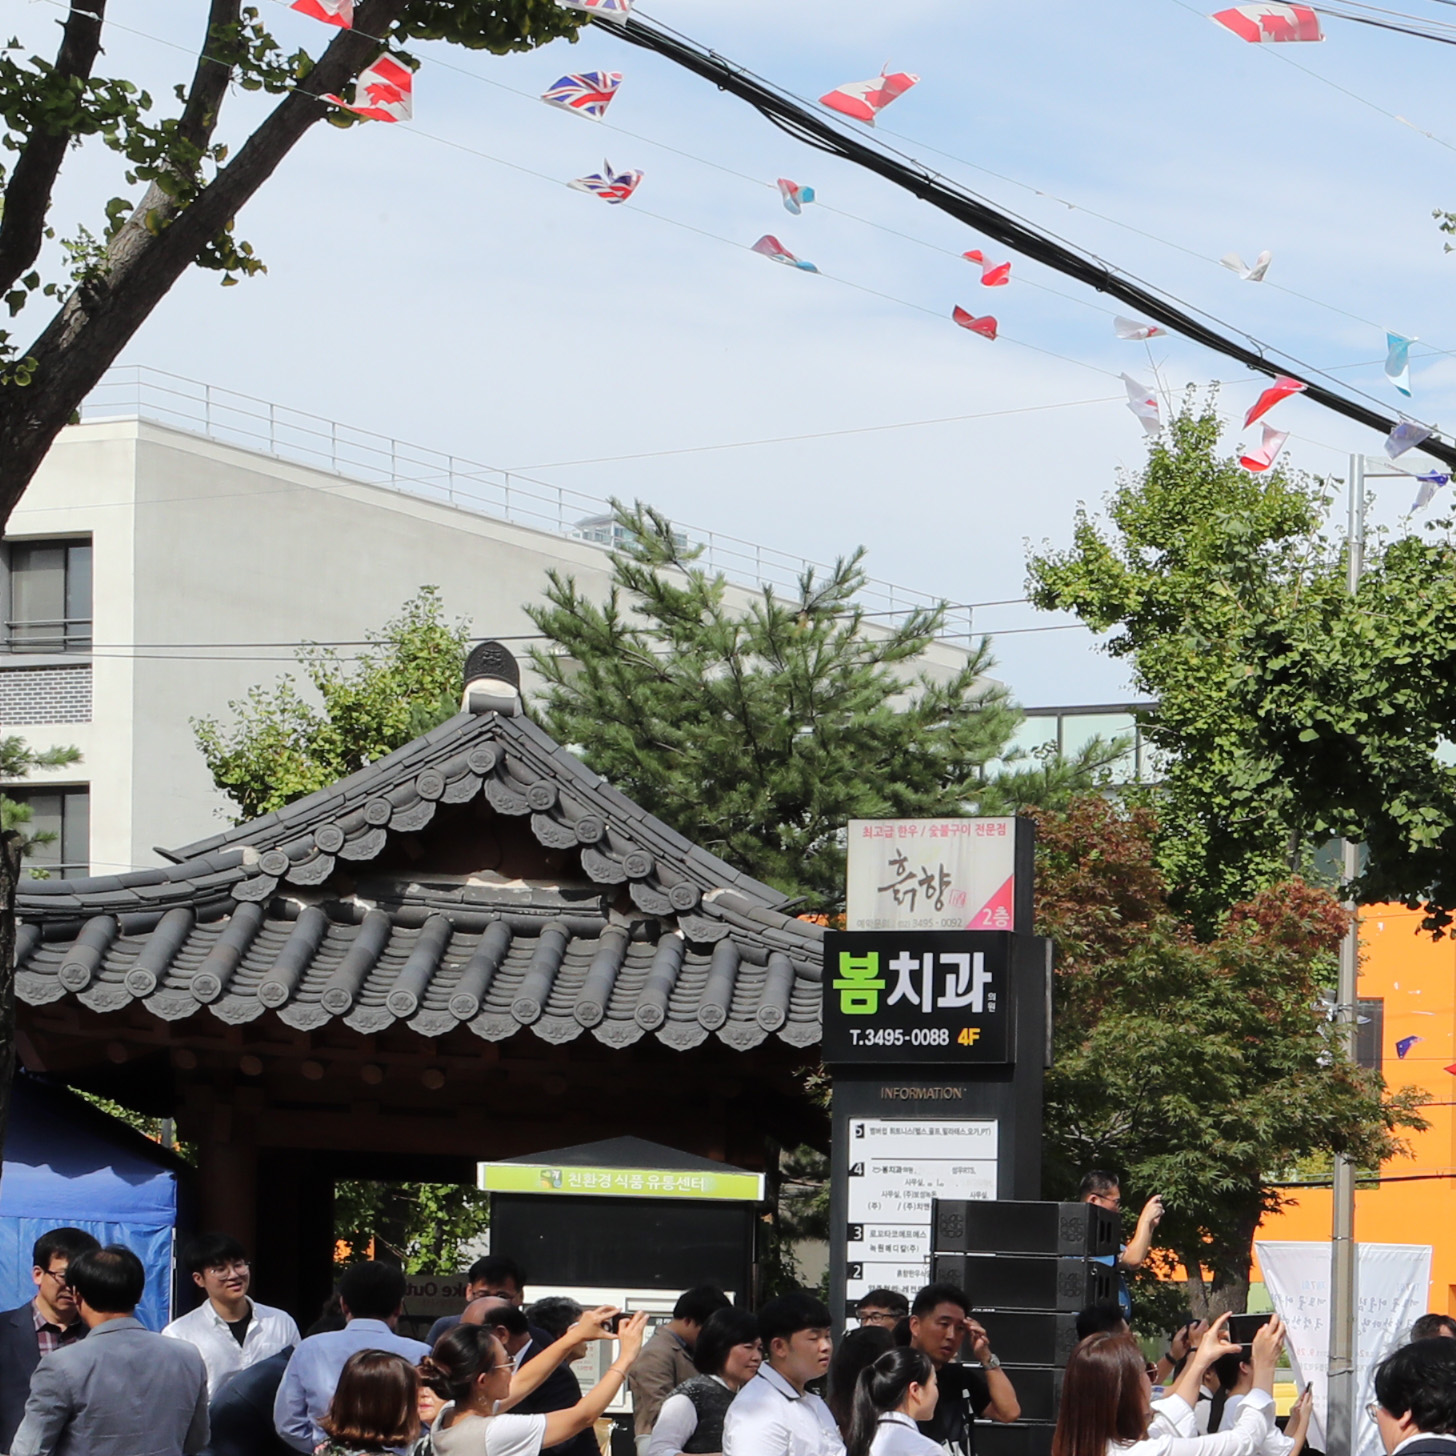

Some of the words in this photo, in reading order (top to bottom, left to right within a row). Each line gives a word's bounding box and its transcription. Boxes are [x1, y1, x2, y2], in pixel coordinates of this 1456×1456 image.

[862, 825, 895, 838] 최고급
[898, 825, 919, 838] 한우
[975, 823, 1007, 836] 전문점
[982, 906, 1010, 927] 2층
[832, 951, 993, 1015] 봄치과
[987, 992, 997, 1013] 의원
[849, 1028, 950, 1046] T.3495-0088
[957, 1027, 981, 1046] 4F
[880, 1087, 963, 1101] INFORMATION
[854, 1164, 864, 1176] 4
[568, 1172, 612, 1189] 친환경
[614, 1174, 645, 1190] 식품
[646, 1175, 705, 1192] 유통센터
[853, 1227, 862, 1240] 3
[852, 1265, 862, 1279] 2
